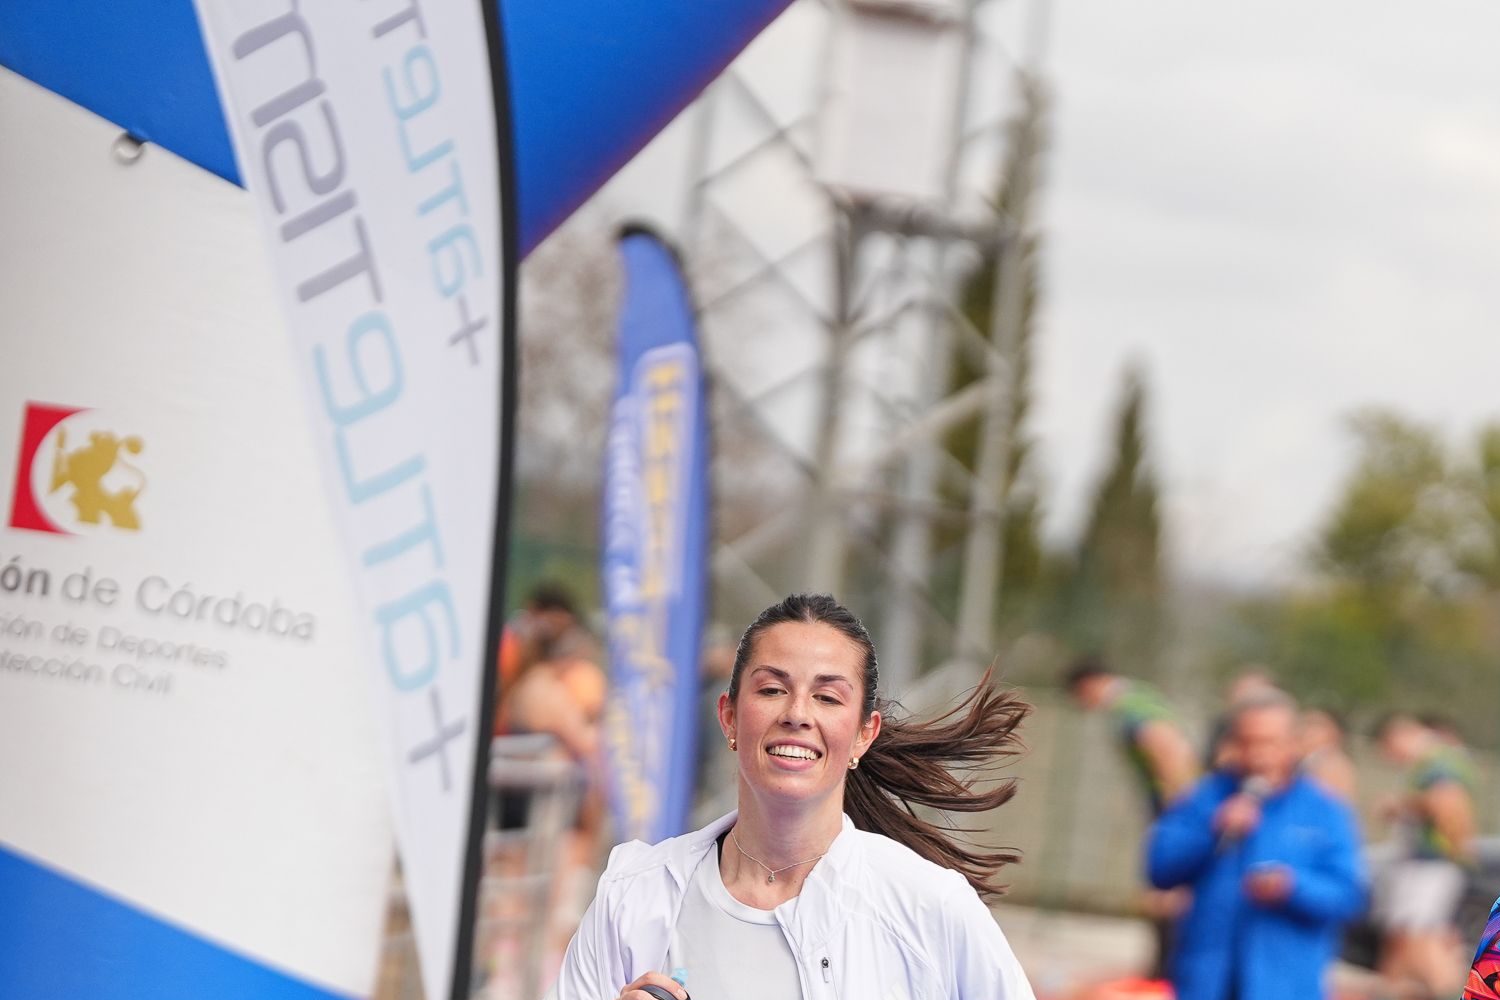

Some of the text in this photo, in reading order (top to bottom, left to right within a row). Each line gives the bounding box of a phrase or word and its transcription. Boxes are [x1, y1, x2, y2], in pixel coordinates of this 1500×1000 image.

[62, 567, 119, 605] de
[136, 575, 316, 641] Córdoba
[52, 621, 90, 646] de
[99, 625, 228, 669] Deportes
